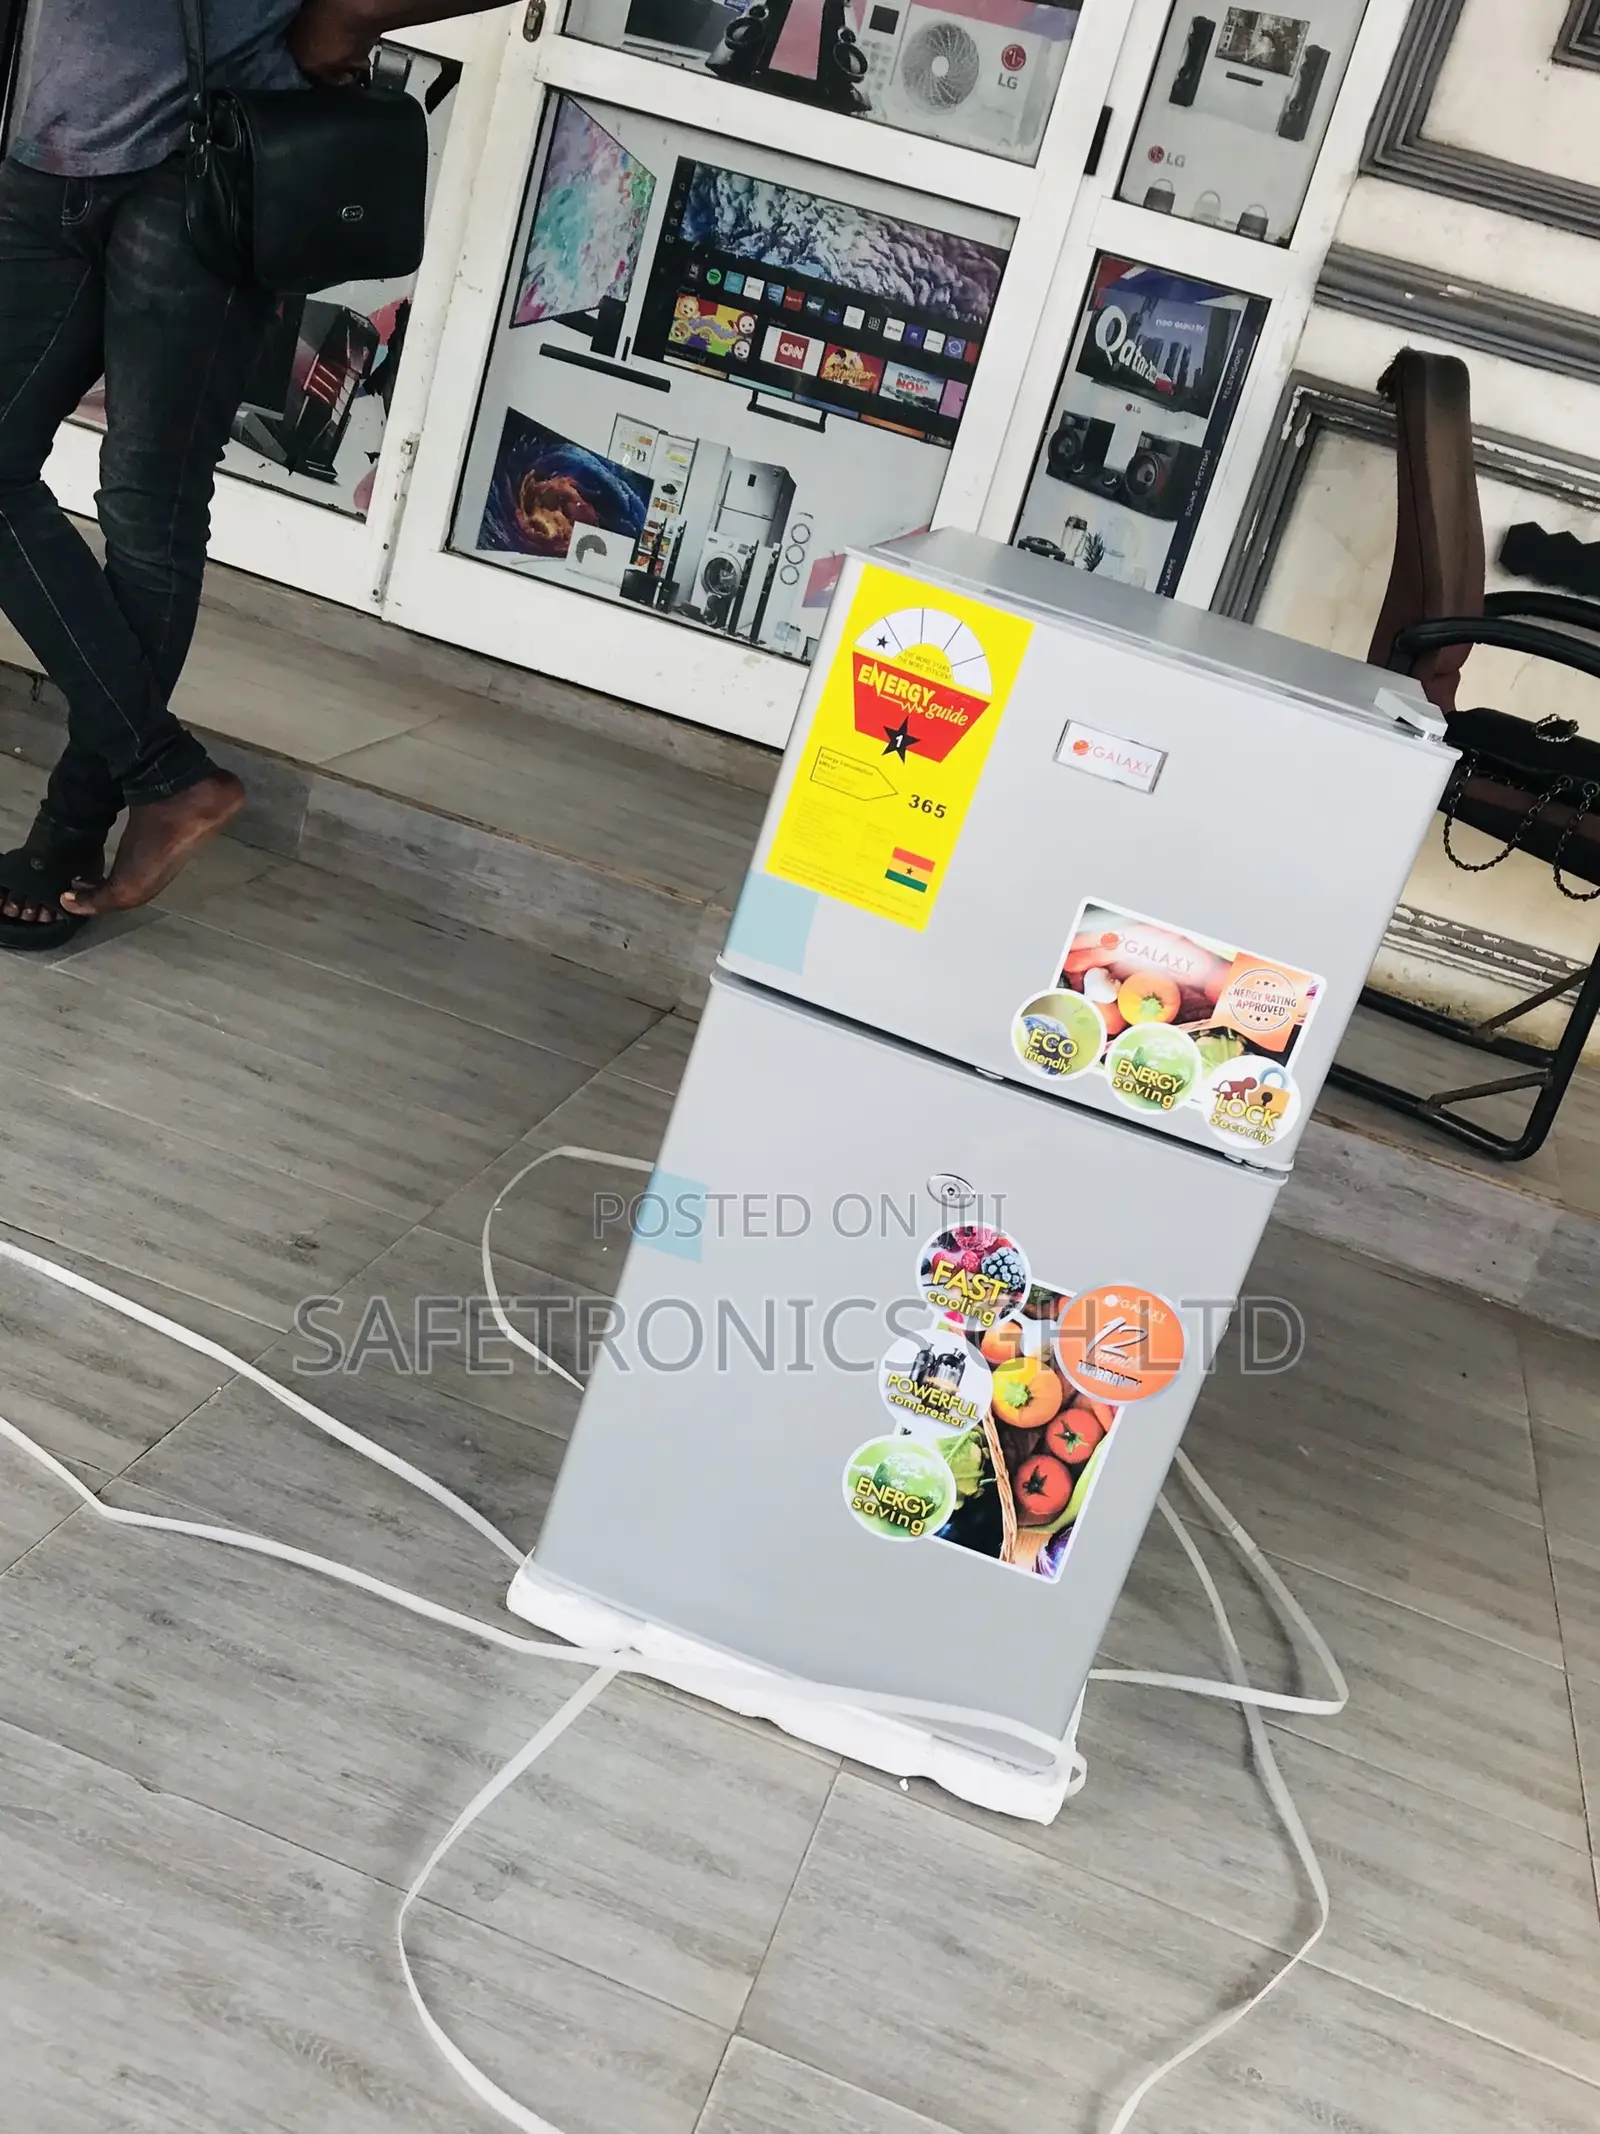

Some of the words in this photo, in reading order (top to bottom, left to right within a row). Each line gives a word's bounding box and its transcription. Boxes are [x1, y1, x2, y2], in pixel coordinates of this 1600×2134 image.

[998, 72, 1018, 90] LG
[1166, 152, 1186, 168] LG
[779, 342, 805, 360] CNN
[858, 661, 936, 707] ENERGY
[925, 703, 969, 727] guide
[895, 734, 904, 748] 1
[1093, 746, 1153, 774] GALAXY
[908, 794, 947, 819] 365
[1125, 939, 1195, 972] GALAXY
[1236, 999, 1287, 1017] APPROVED
[1265, 993, 1298, 1008] RATING
[1029, 1028, 1079, 1059] ECO
[1024, 1048, 1072, 1076] friendly
[1116, 1059, 1184, 1093] ENERGY
[1113, 1076, 1176, 1110] saving
[1214, 1093, 1281, 1132] LOCK
[1209, 1112, 1274, 1147] Security
[931, 1259, 1009, 1306] FAST
[926, 1289, 997, 1328] cooling
[1119, 1299, 1168, 1322] GALAXY
[1086, 1316, 1149, 1359] 12
[886, 1372, 980, 1421] POWERFUL
[886, 1392, 968, 1429] compressor
[856, 1476, 935, 1518] ENERGY
[852, 1496, 925, 1536] saving
